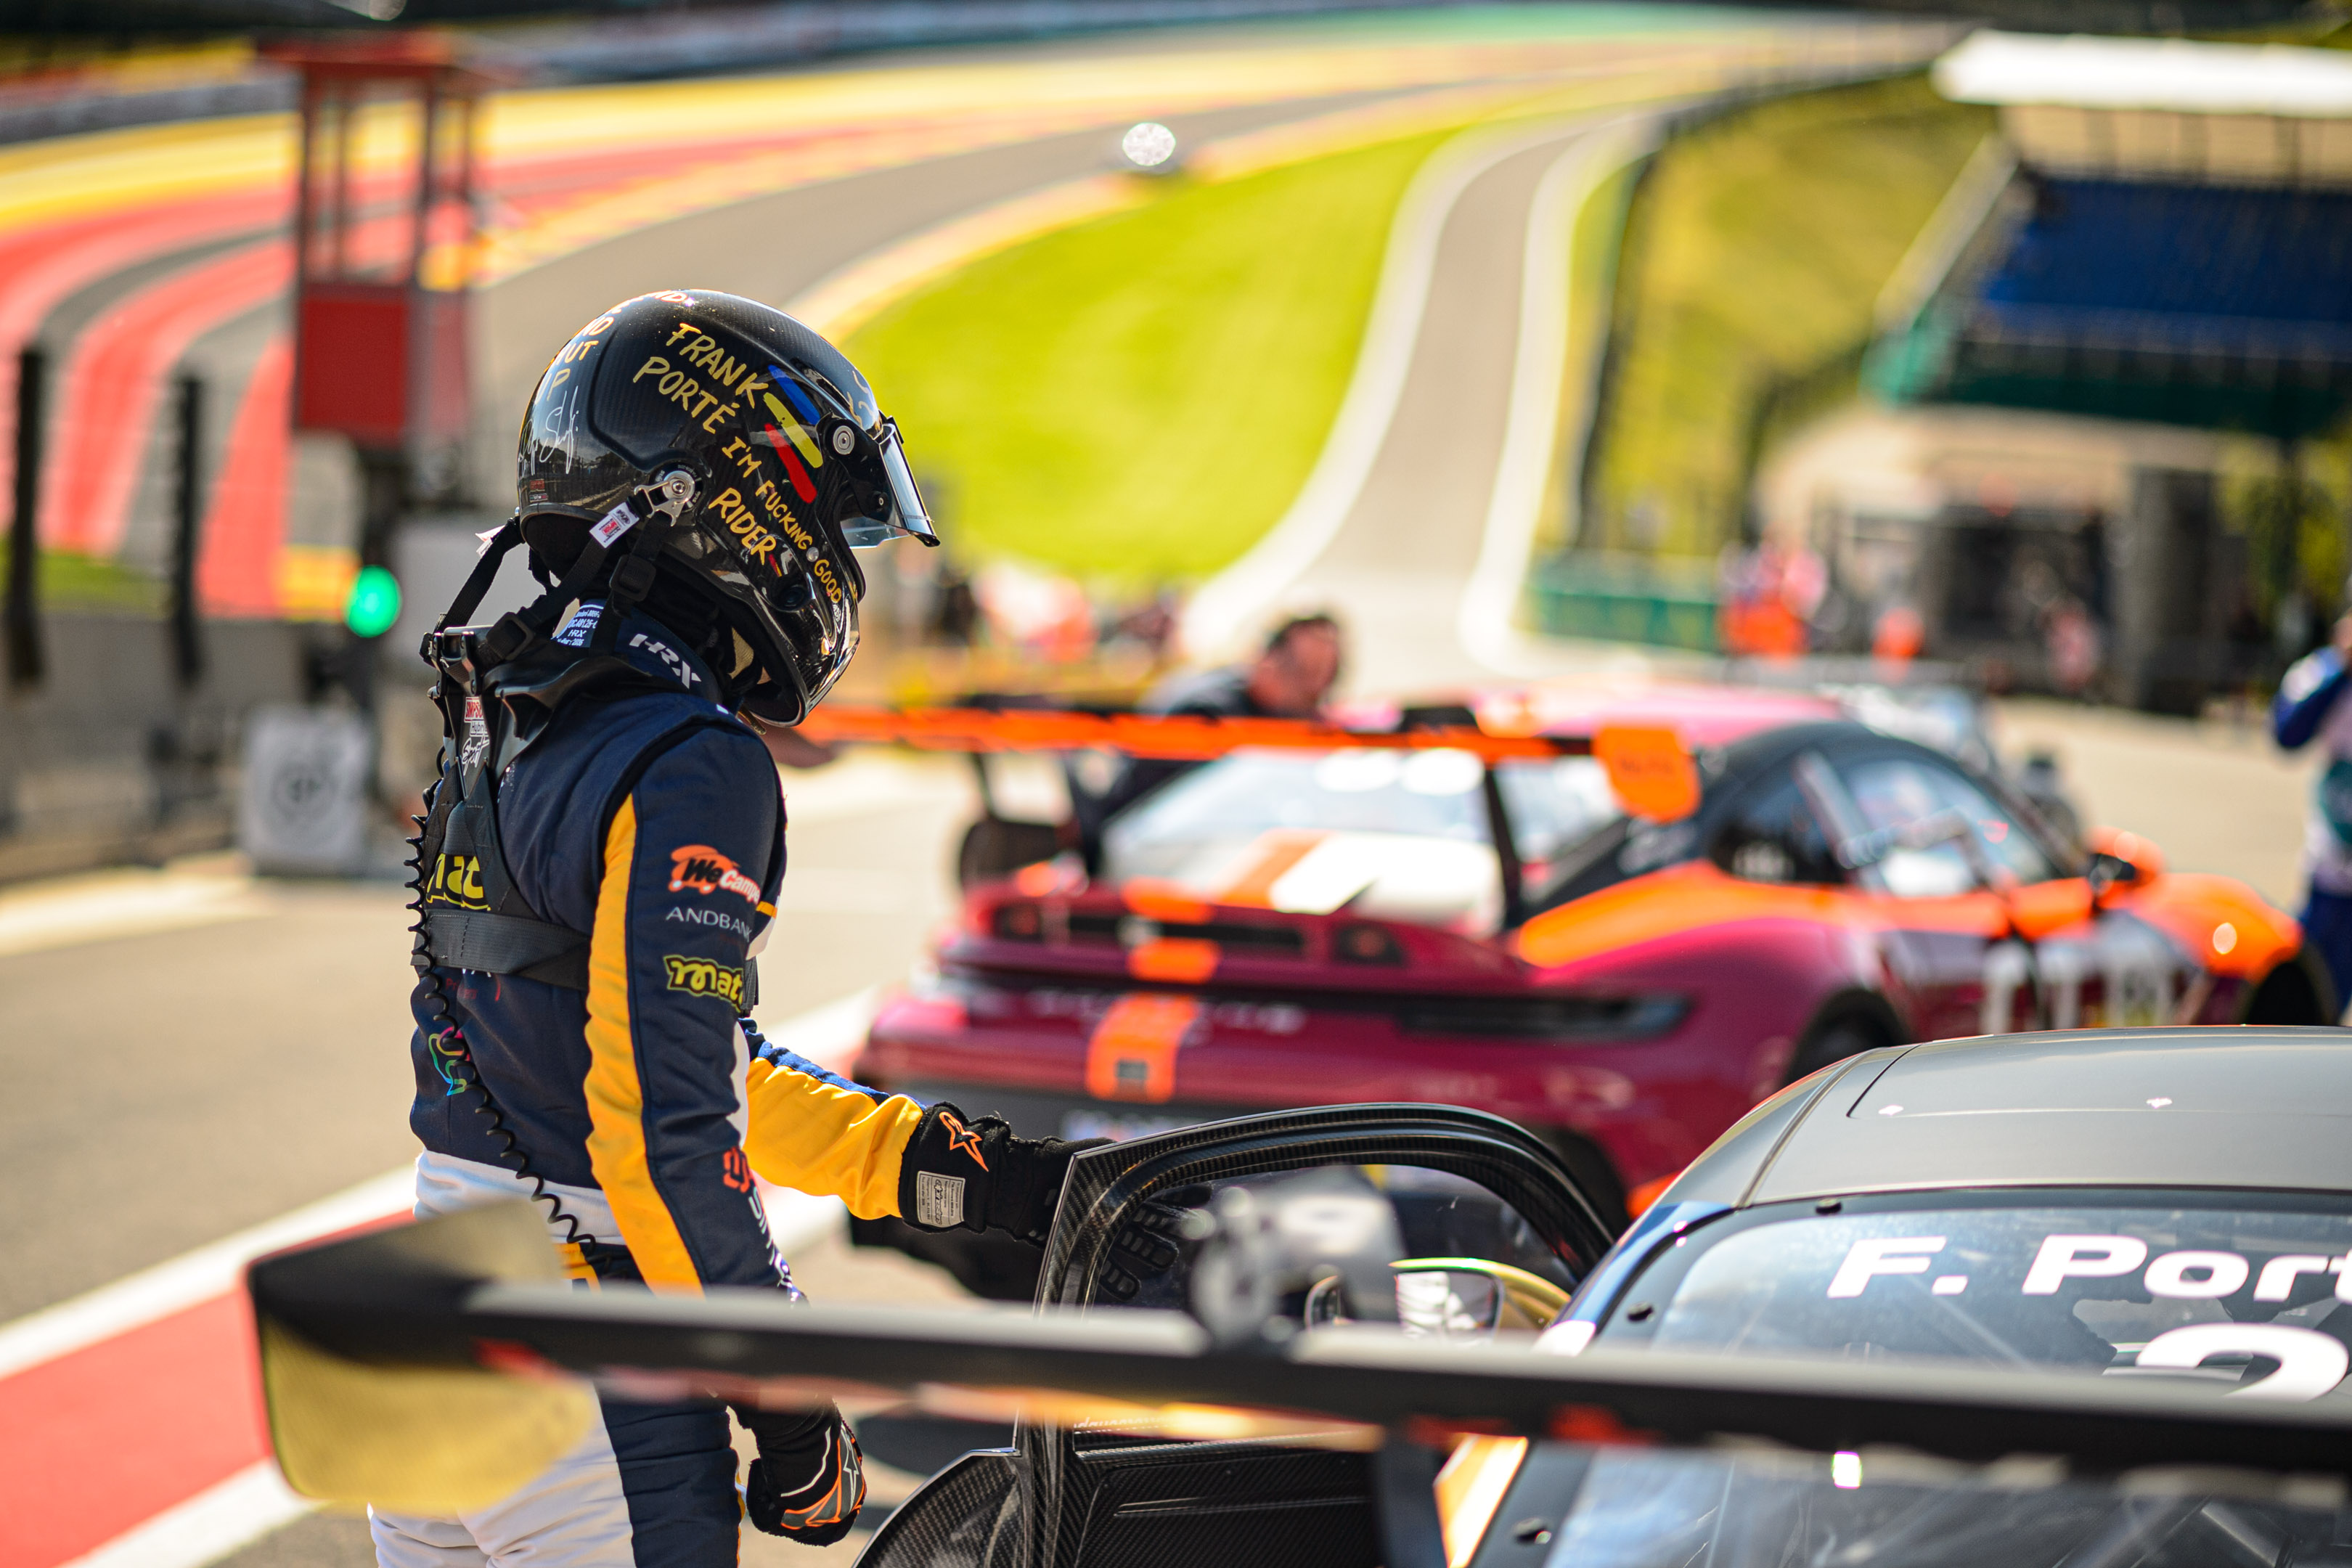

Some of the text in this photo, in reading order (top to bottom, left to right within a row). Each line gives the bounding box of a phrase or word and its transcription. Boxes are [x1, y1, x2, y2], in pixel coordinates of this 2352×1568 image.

[632, 356, 740, 434] PORTÉ
[666, 322, 769, 409] FRANK
[708, 487, 777, 565] RIDER
[722, 436, 842, 603] I'M FUCKING GOOD
[629, 634, 702, 689] HRX
[1826, 1236, 1969, 1299] F.
